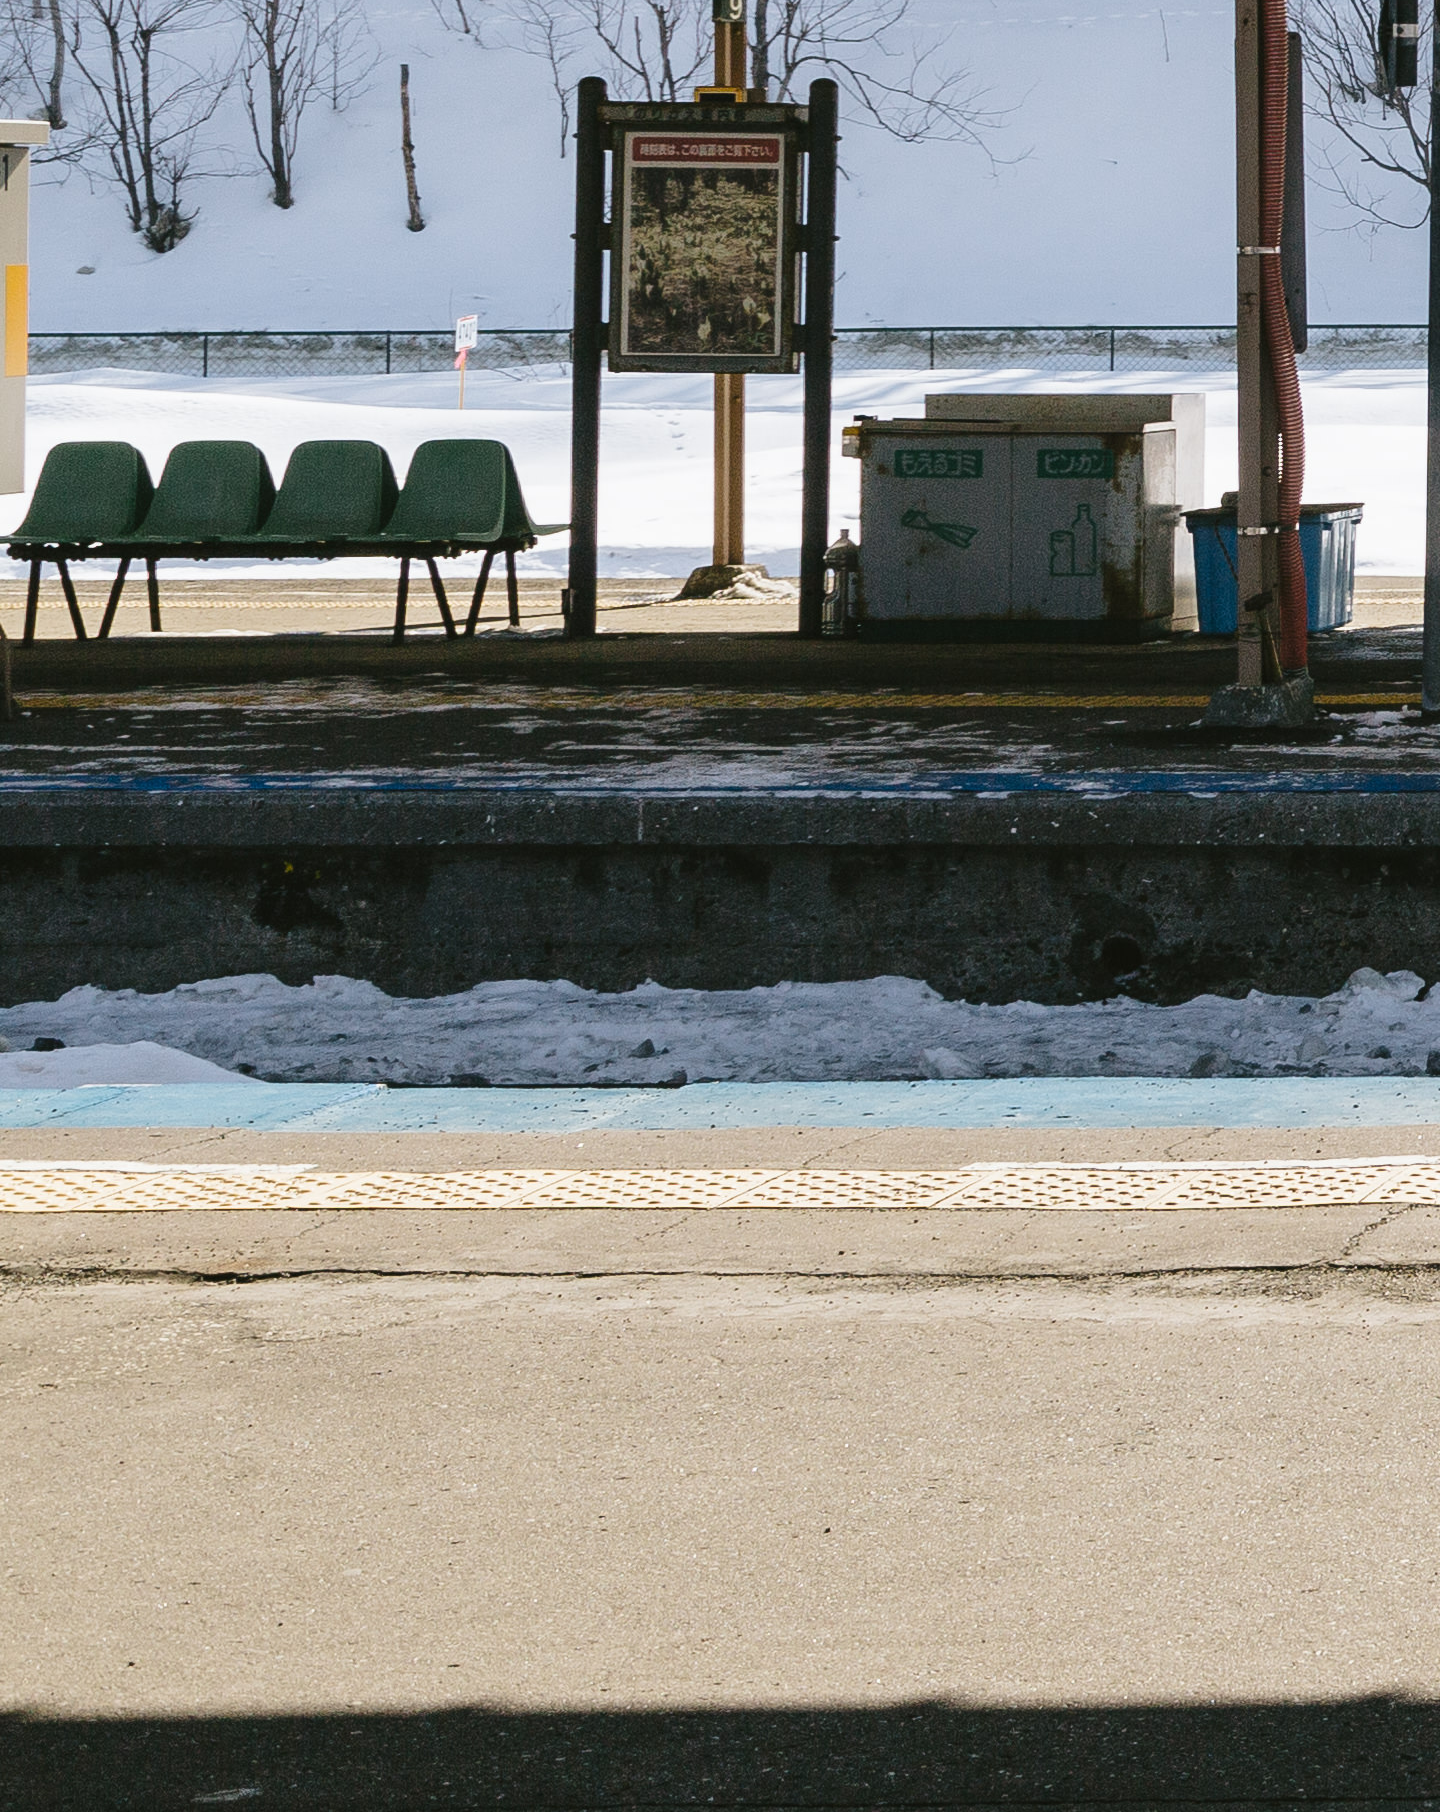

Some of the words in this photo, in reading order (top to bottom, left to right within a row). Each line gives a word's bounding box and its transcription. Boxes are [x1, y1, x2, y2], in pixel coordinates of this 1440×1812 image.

[901, 452, 977, 475] もえるゴミ
